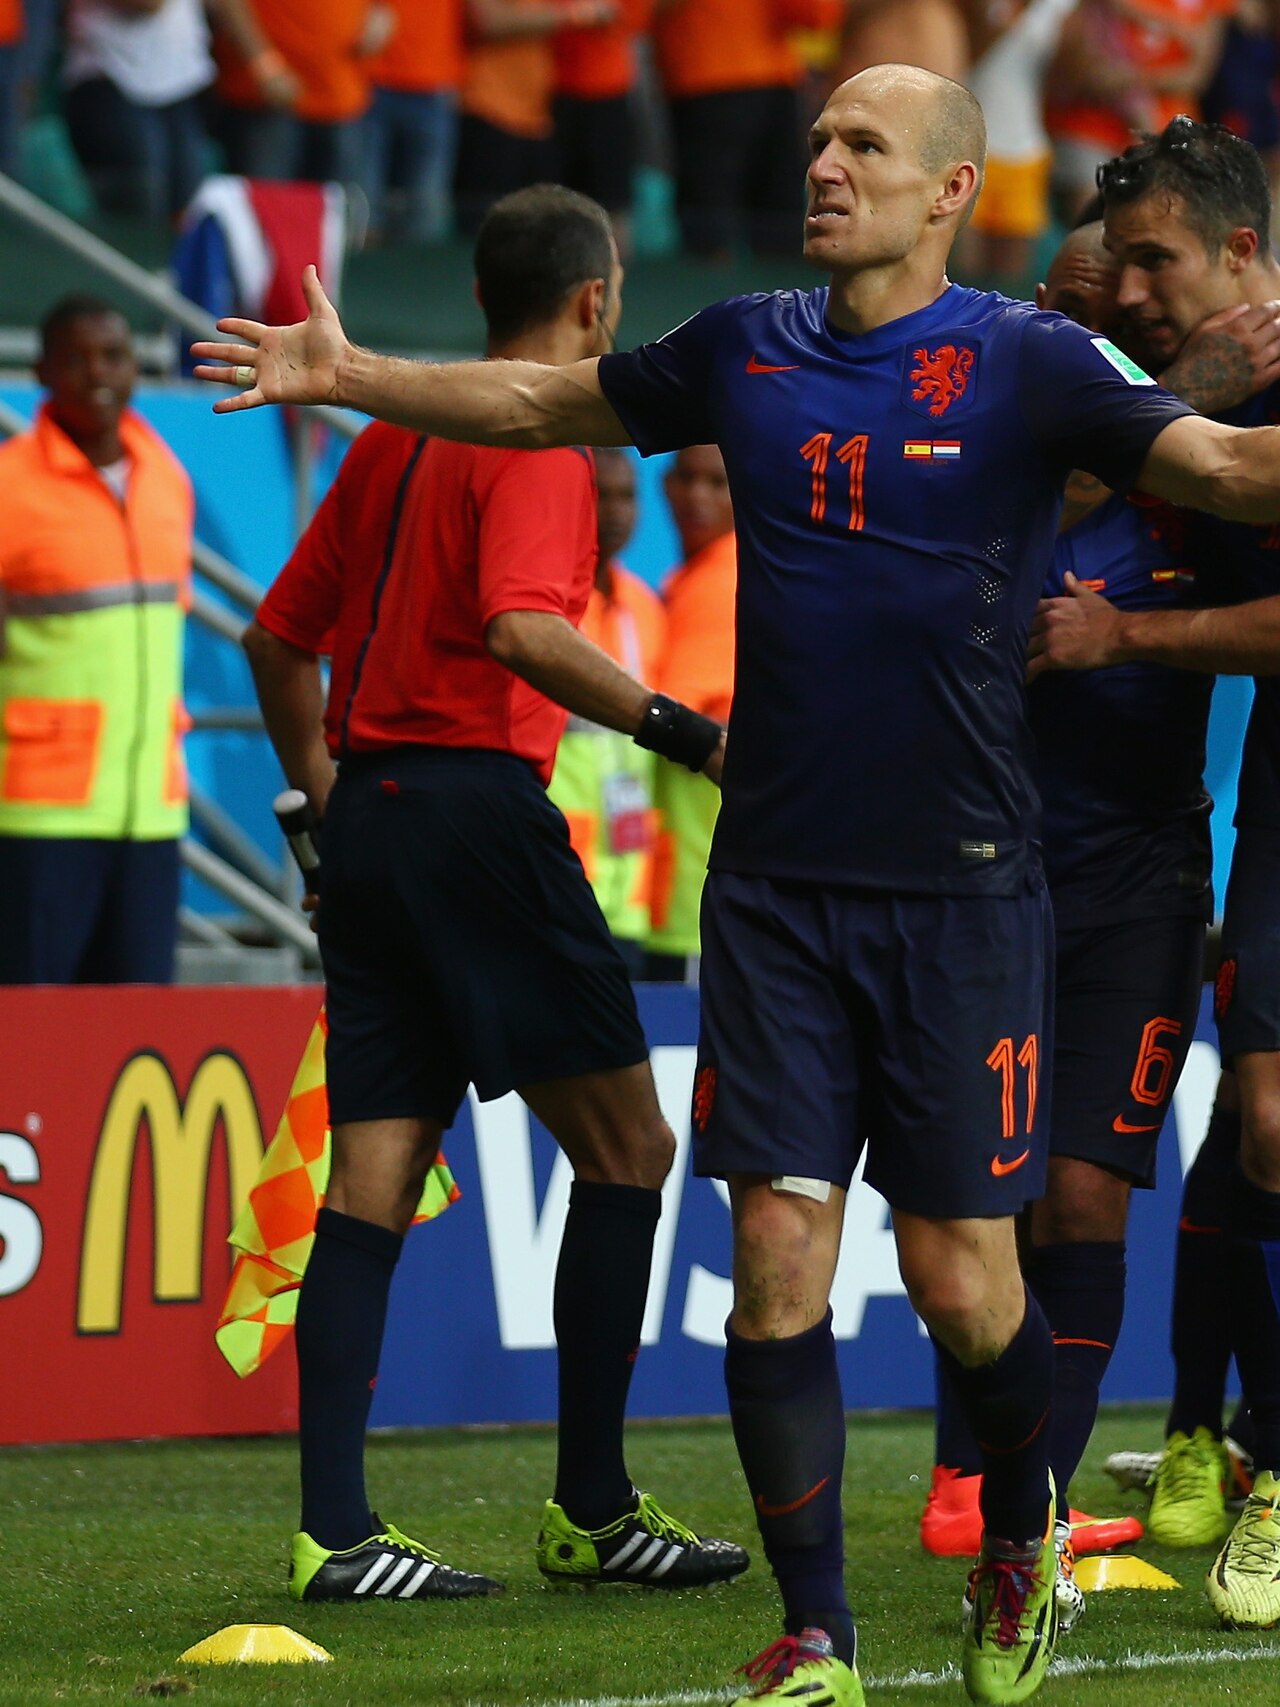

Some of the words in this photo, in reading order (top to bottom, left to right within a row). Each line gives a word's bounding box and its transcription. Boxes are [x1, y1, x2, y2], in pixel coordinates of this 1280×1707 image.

[799, 433, 869, 531] 11
[985, 1033, 1038, 1138] 11
[1131, 1016, 1182, 1107] 6
